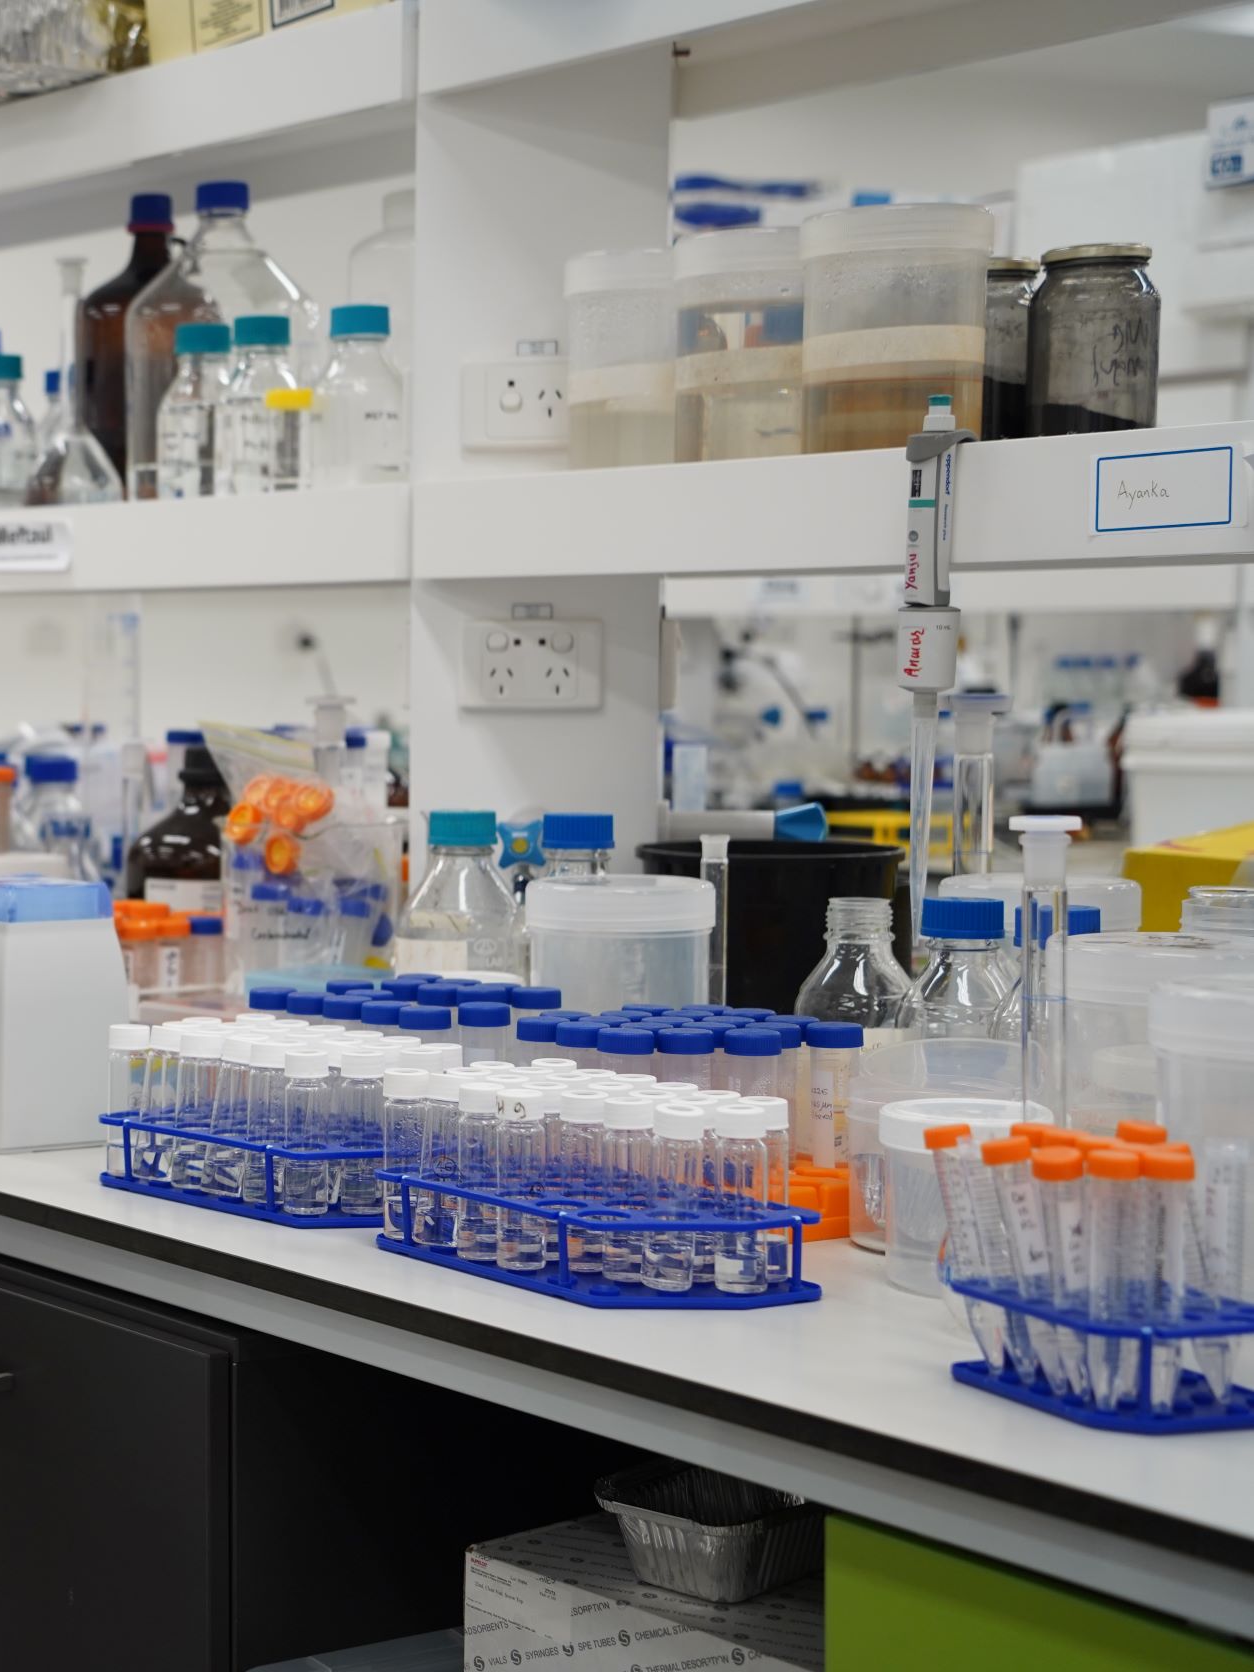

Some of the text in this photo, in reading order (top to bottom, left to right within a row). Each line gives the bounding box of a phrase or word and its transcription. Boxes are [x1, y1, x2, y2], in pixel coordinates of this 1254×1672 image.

[464, 1621, 509, 1636] ADSORBENTS
[488, 1655, 508, 1666] VIALS
[525, 1647, 560, 1660] SYRINGES
[578, 1640, 592, 1652] SPE
[593, 1637, 617, 1649] TUBES
[634, 1626, 673, 1642] CHEMICAL
